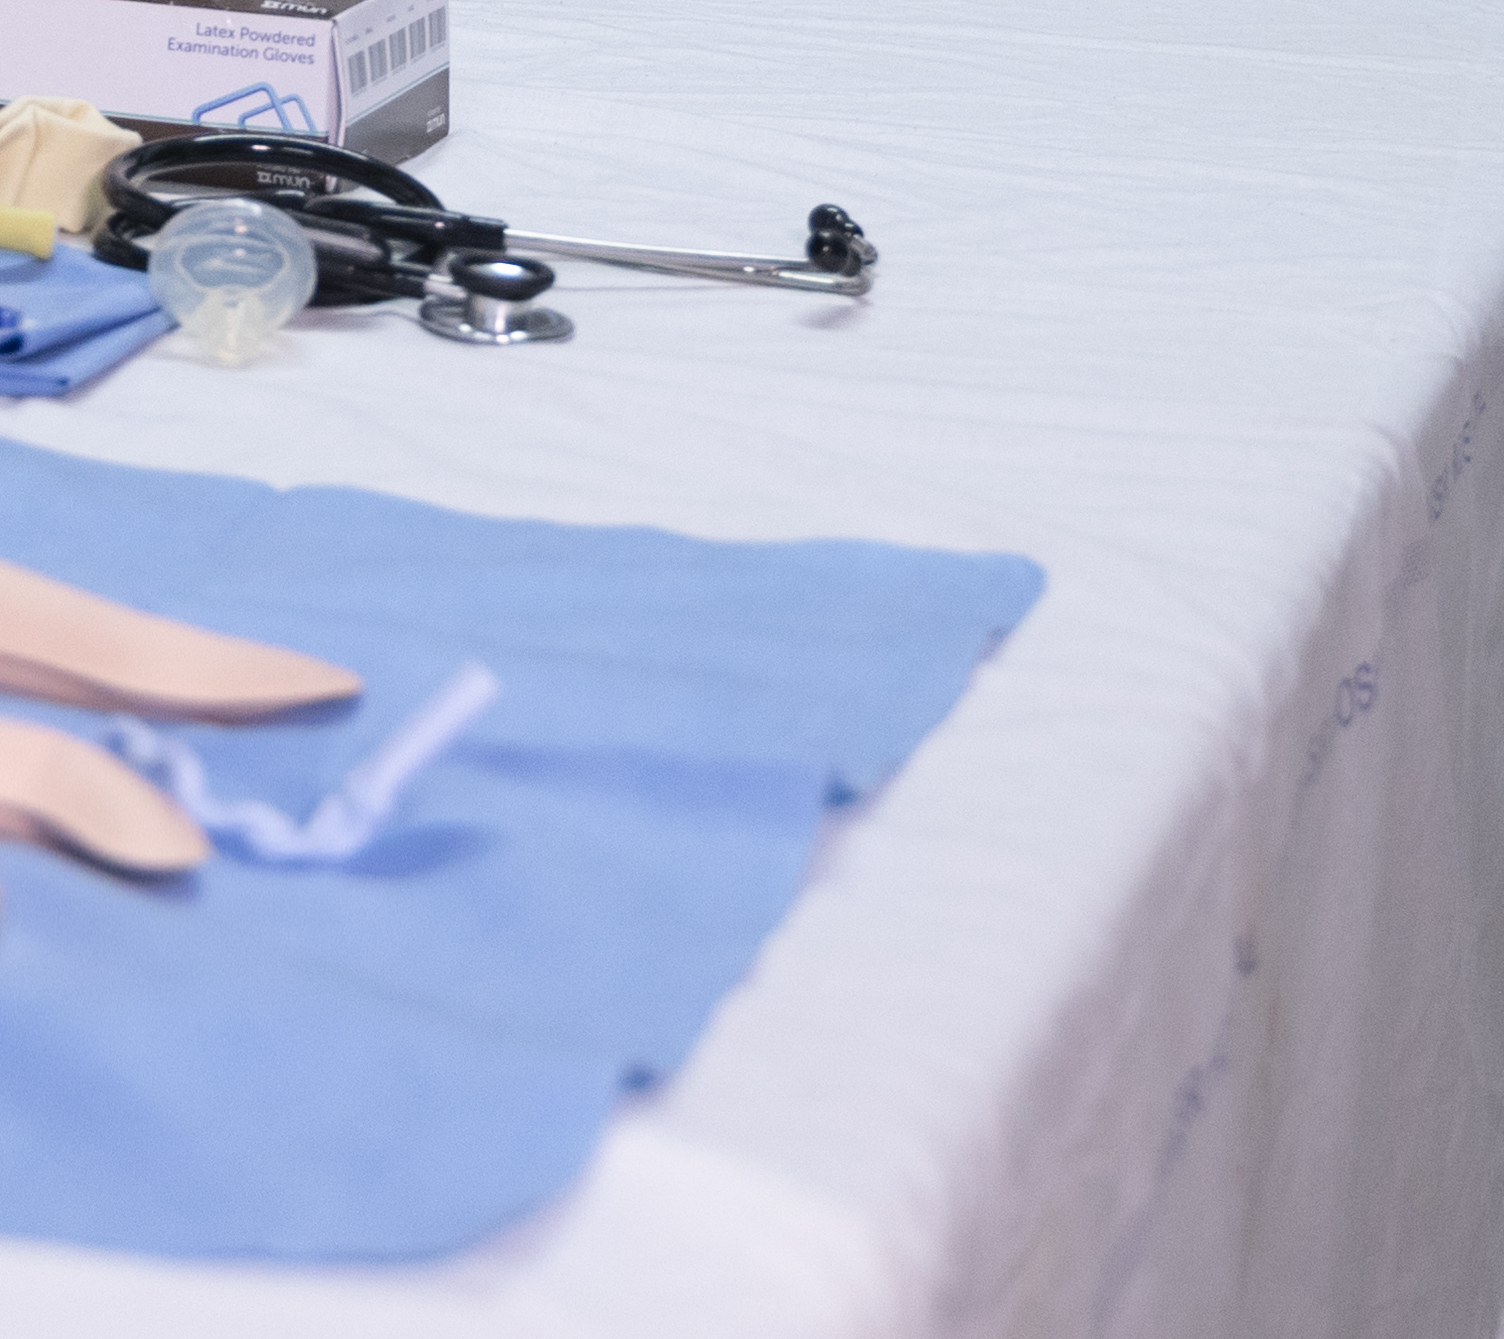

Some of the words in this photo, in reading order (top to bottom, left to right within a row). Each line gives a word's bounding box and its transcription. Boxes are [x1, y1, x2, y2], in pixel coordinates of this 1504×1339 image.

[196, 23, 235, 39] Latex
[240, 27, 316, 47] Powdered
[167, 37, 259, 59] Examination
[263, 47, 315, 65] Gloves
